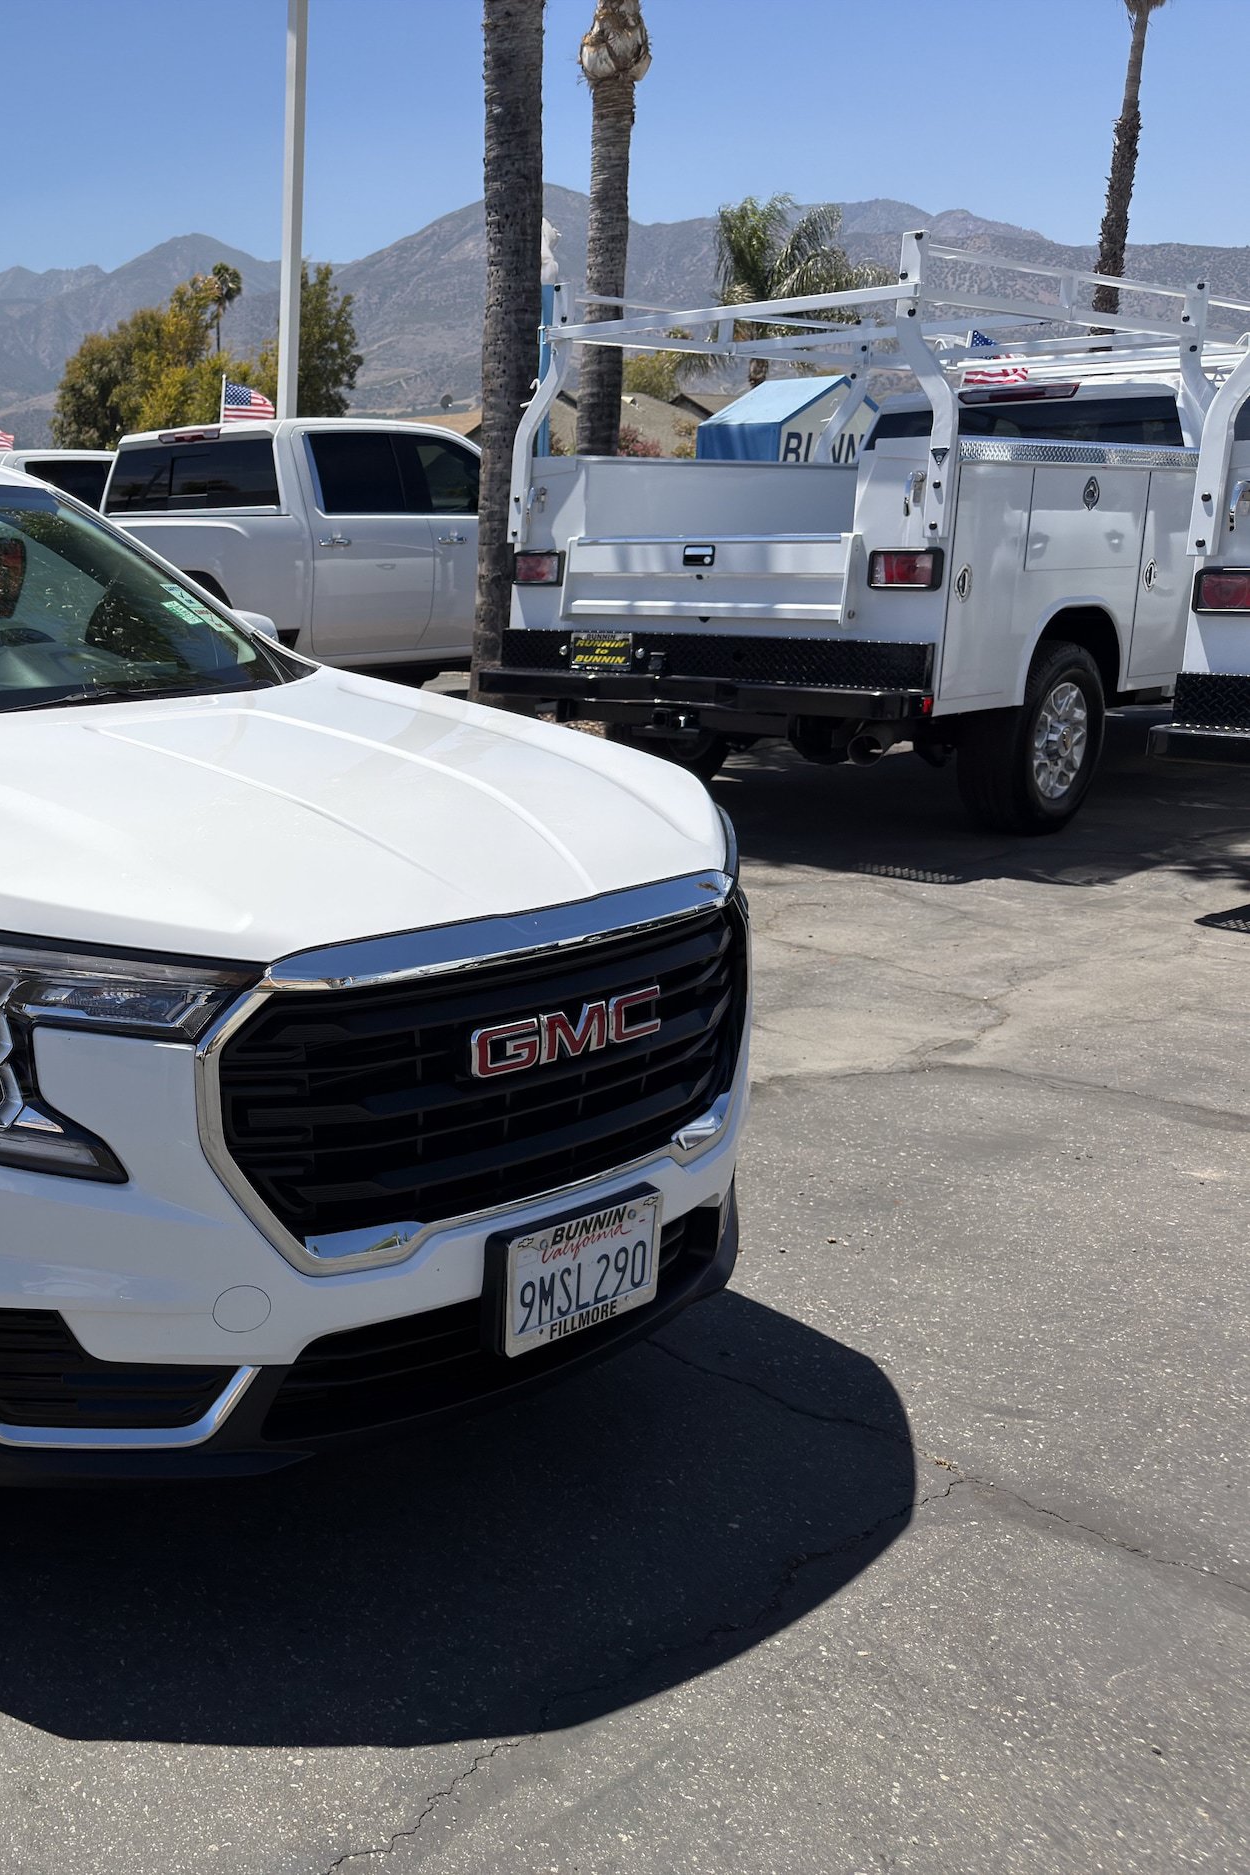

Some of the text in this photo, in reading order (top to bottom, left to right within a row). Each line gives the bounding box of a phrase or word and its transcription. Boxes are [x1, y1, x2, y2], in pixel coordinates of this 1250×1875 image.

[575, 655, 626, 663] BUNNIN
[471, 985, 661, 1078] GMC
[551, 1206, 627, 1246] BUNNIN
[518, 1240, 647, 1334] 9MSL290
[550, 1300, 618, 1339] FILLMORE
